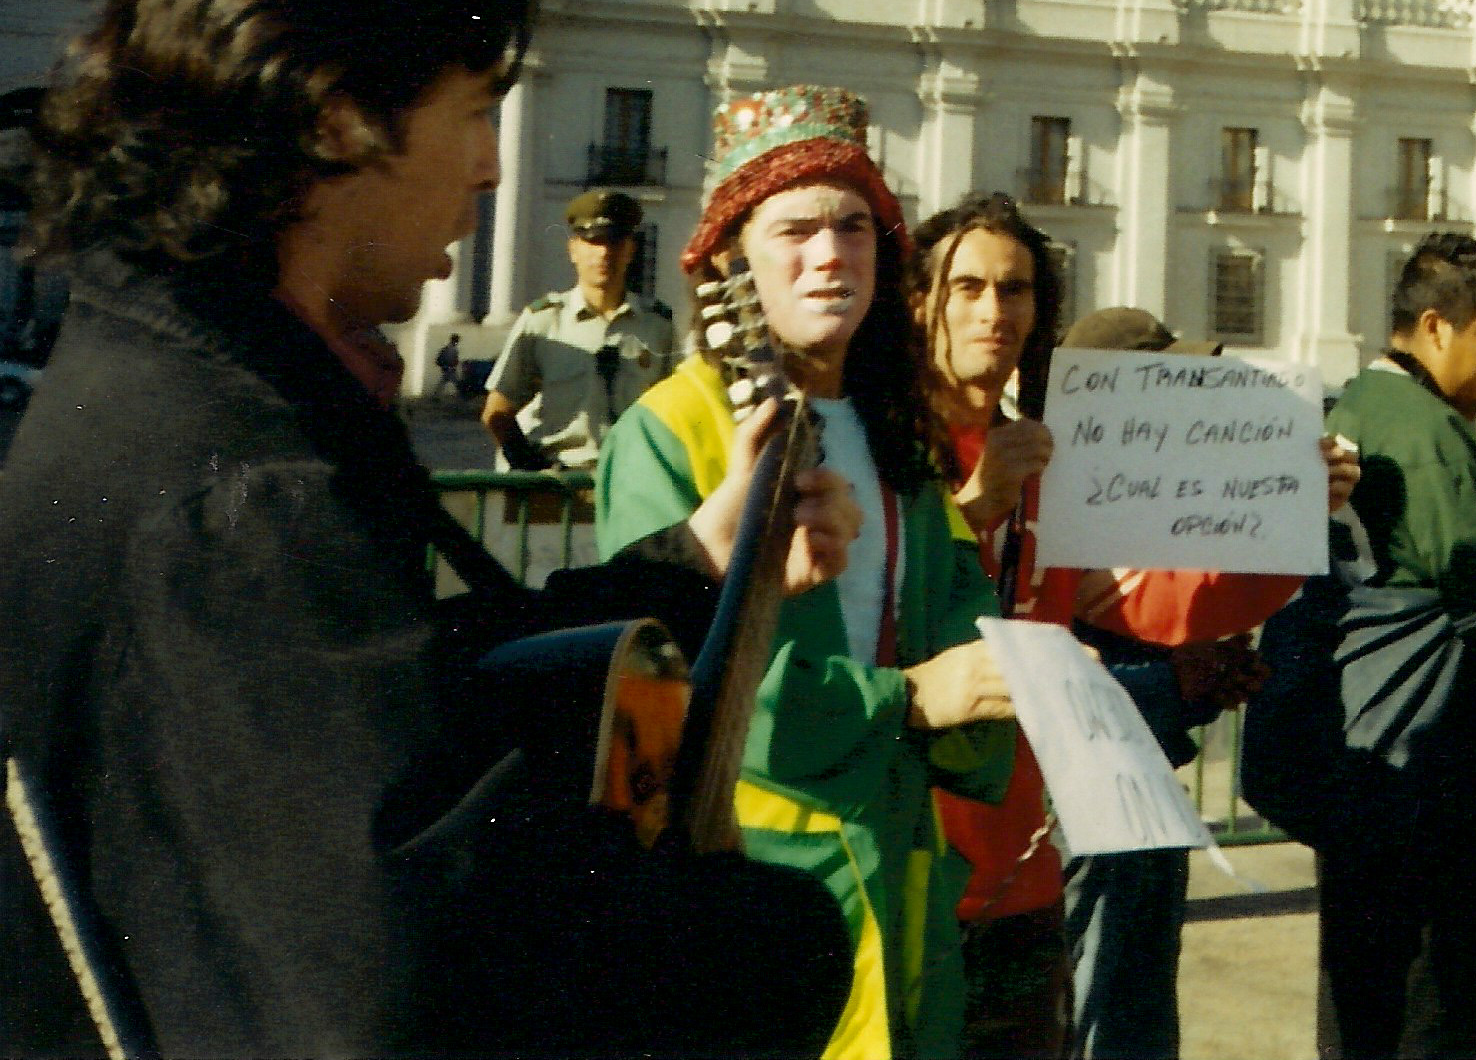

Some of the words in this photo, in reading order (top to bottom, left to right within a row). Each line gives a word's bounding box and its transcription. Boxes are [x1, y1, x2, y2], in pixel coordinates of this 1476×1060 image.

[1061, 364, 1119, 394] CON
[1071, 416, 1104, 446] NO
[1121, 418, 1168, 452] HAY
[1186, 416, 1293, 446] CANCIÓN
[1085, 467, 1160, 505] ¿CUAL
[1176, 479, 1203, 499] ES
